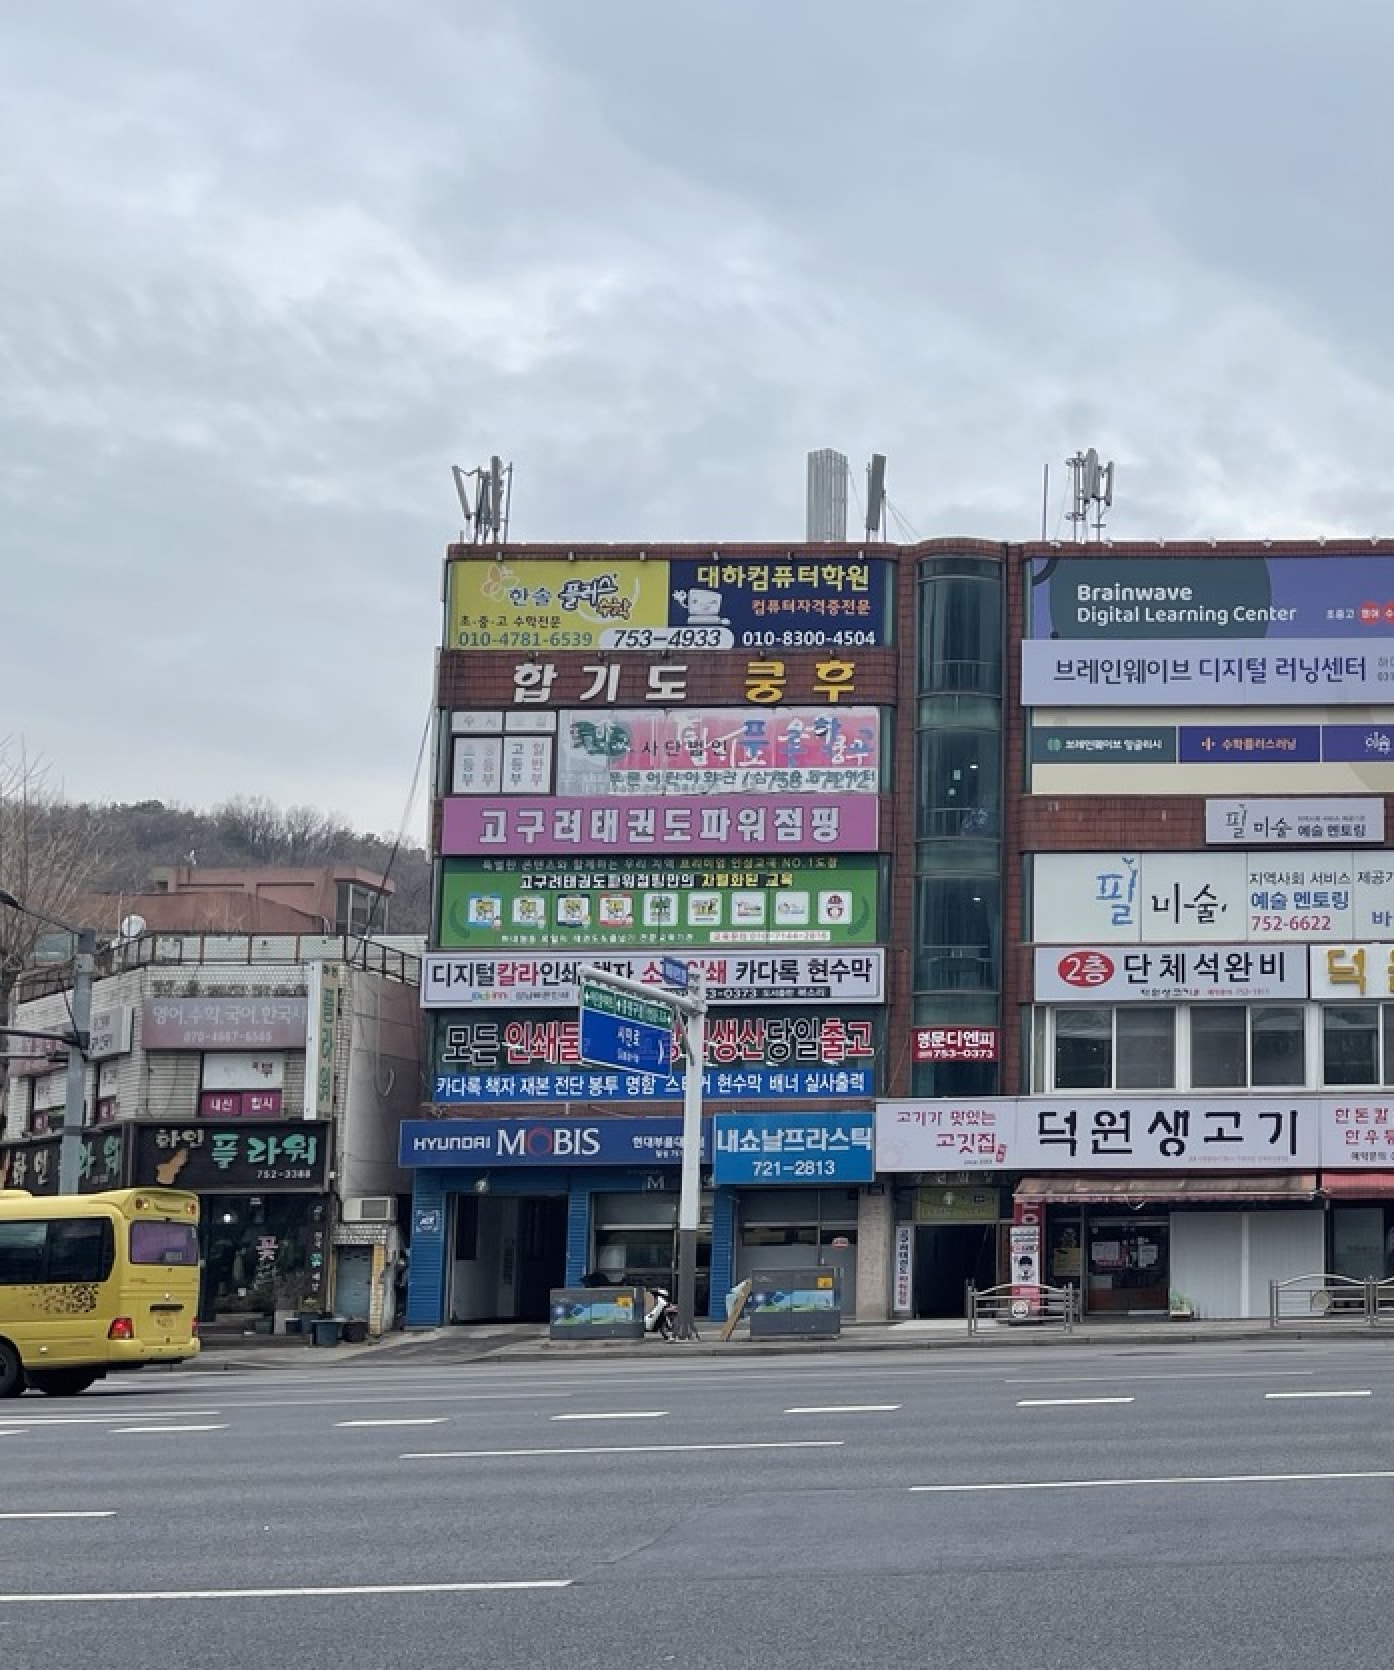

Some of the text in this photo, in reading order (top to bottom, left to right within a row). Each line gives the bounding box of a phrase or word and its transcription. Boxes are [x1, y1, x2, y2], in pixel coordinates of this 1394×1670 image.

[697, 565, 869, 591] 대하컴퓨터학원
[1077, 582, 1193, 601] Brainwave
[1077, 605, 1297, 627] Digital Learning Center
[459, 632, 593, 647] 010-4781-6539
[614, 629, 721, 648] 753-4933
[742, 630, 876, 646] 010-8300-4504
[513, 659, 856, 703] 합기도 쿵후
[1053, 656, 1366, 685] 브레인웨이브 디지털 러닝센터
[479, 806, 841, 845] 고구려태권도파워점핑
[1249, 870, 1305, 886] 지역사회
[1310, 870, 1351, 886] 서비스
[1251, 890, 1349, 911] 예술 멘토링
[1251, 915, 1332, 931] 752-6622
[735, 959, 800, 985] 카다록
[807, 957, 873, 984] 현수막
[1065, 951, 1286, 985] 2층 단체석완비
[442, 1023, 502, 1068] 모든
[717, 1073, 763, 1093] 현수막
[769, 1073, 799, 1092] 배너
[897, 1109, 997, 1127] 고기가 맛있는
[413, 1127, 601, 1157] HYUNDAI MOBIS
[717, 1127, 873, 1153] 내쇼날프라스틱
[936, 1132, 996, 1155] 고깃집
[1038, 1108, 1300, 1157] 덕원생고기
[211, 1132, 317, 1169] 플라워
[752, 1159, 836, 1177] 721-2813
